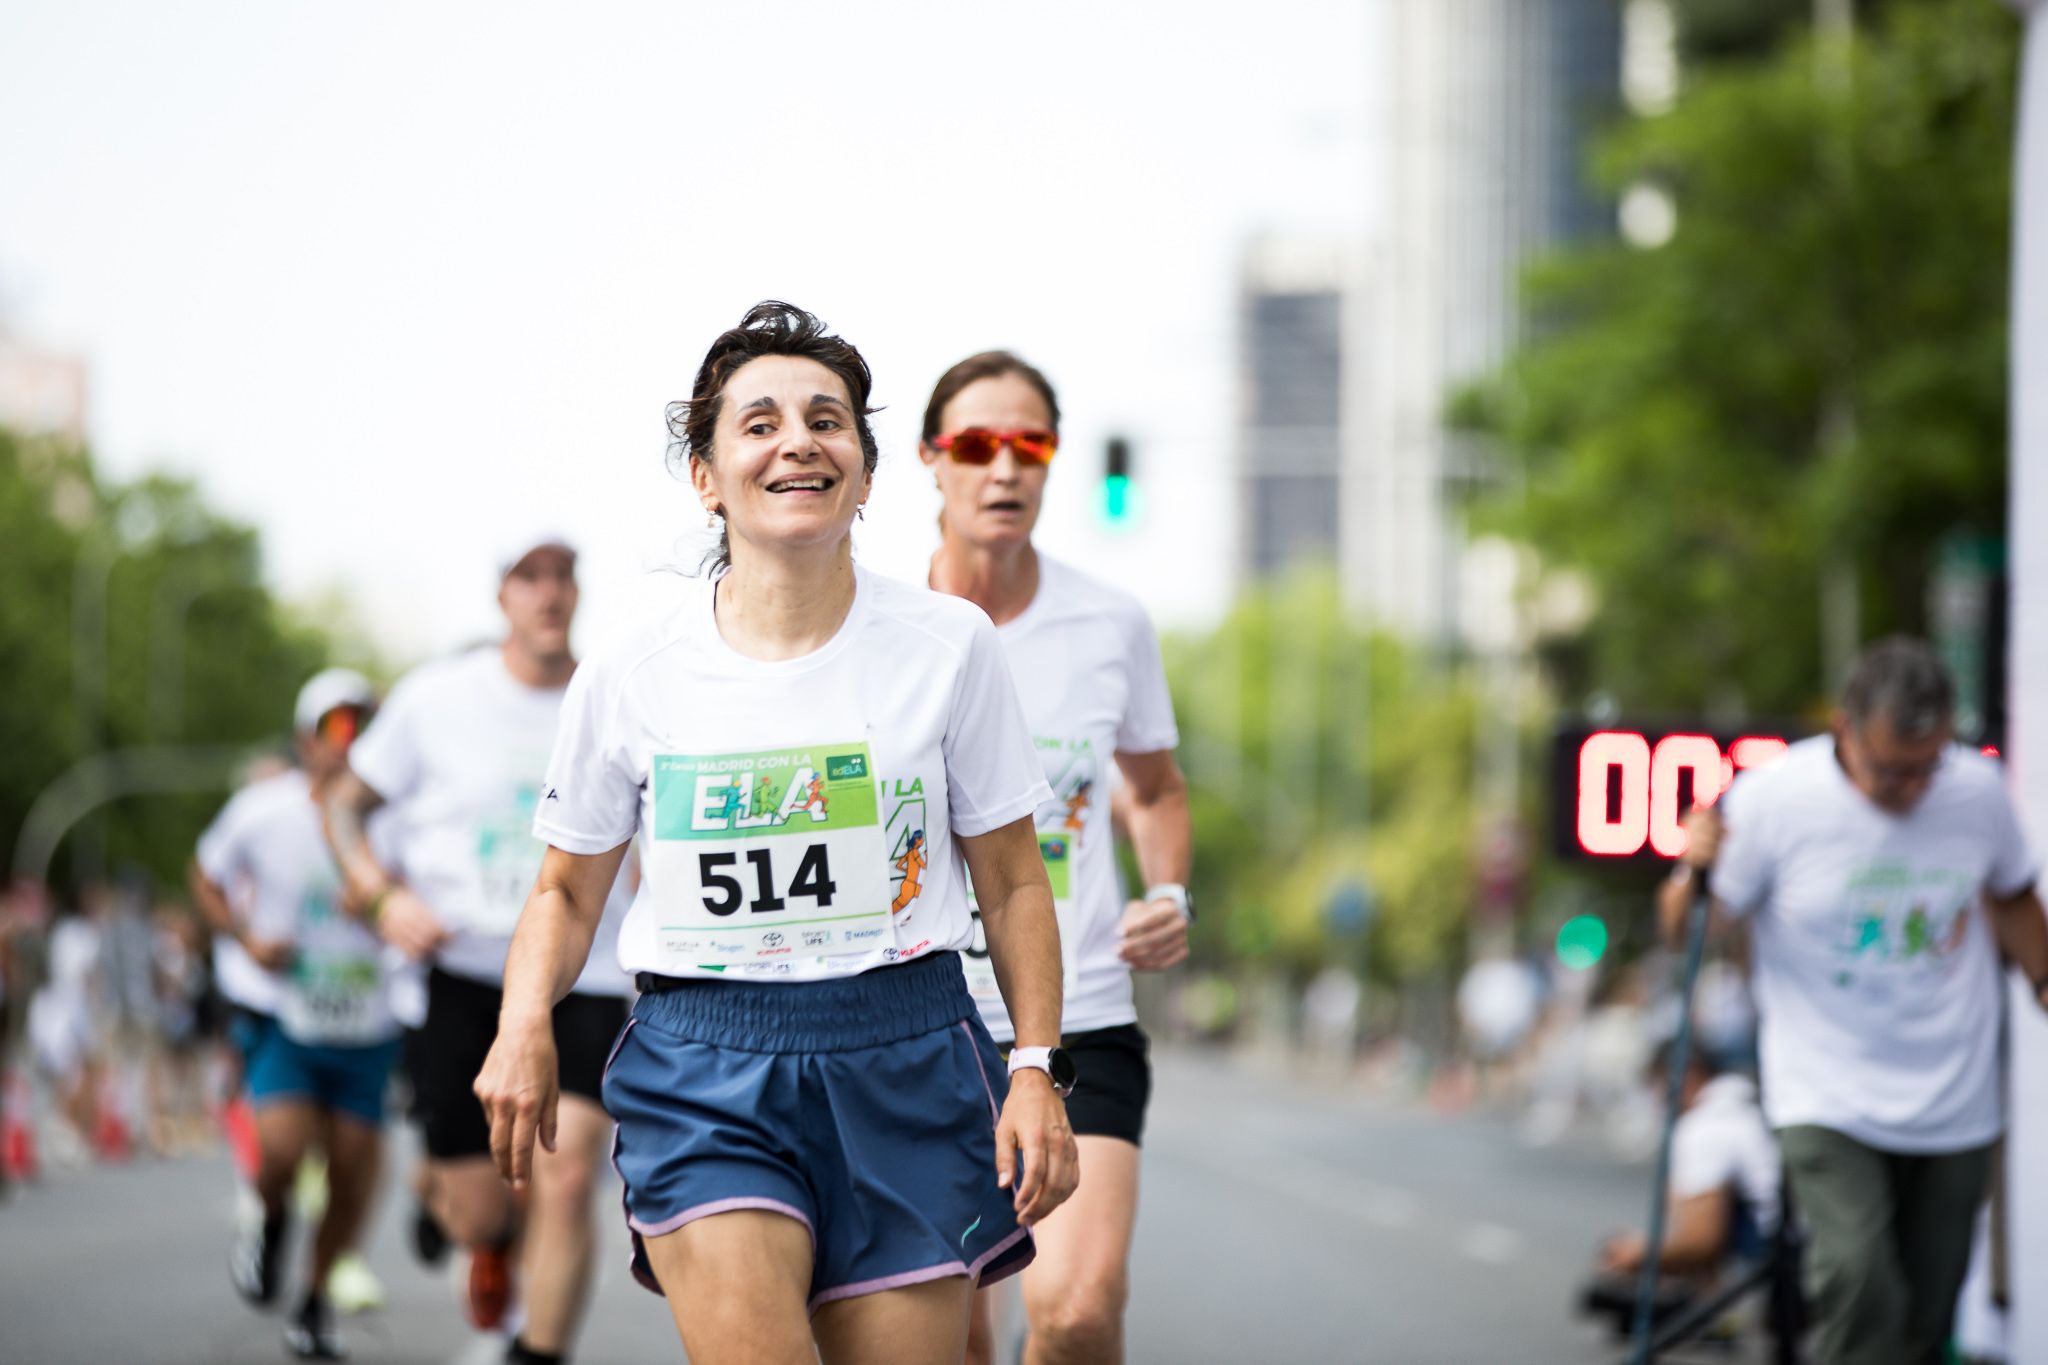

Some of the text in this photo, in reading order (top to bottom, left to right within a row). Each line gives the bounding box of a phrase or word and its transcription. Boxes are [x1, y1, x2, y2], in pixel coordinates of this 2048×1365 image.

[696, 759, 754, 773] MADRID
[757, 755, 790, 770] CON
[791, 751, 812, 766] LA
[689, 766, 829, 831] ELA
[894, 776, 924, 797] LA
[698, 843, 837, 917] 514
